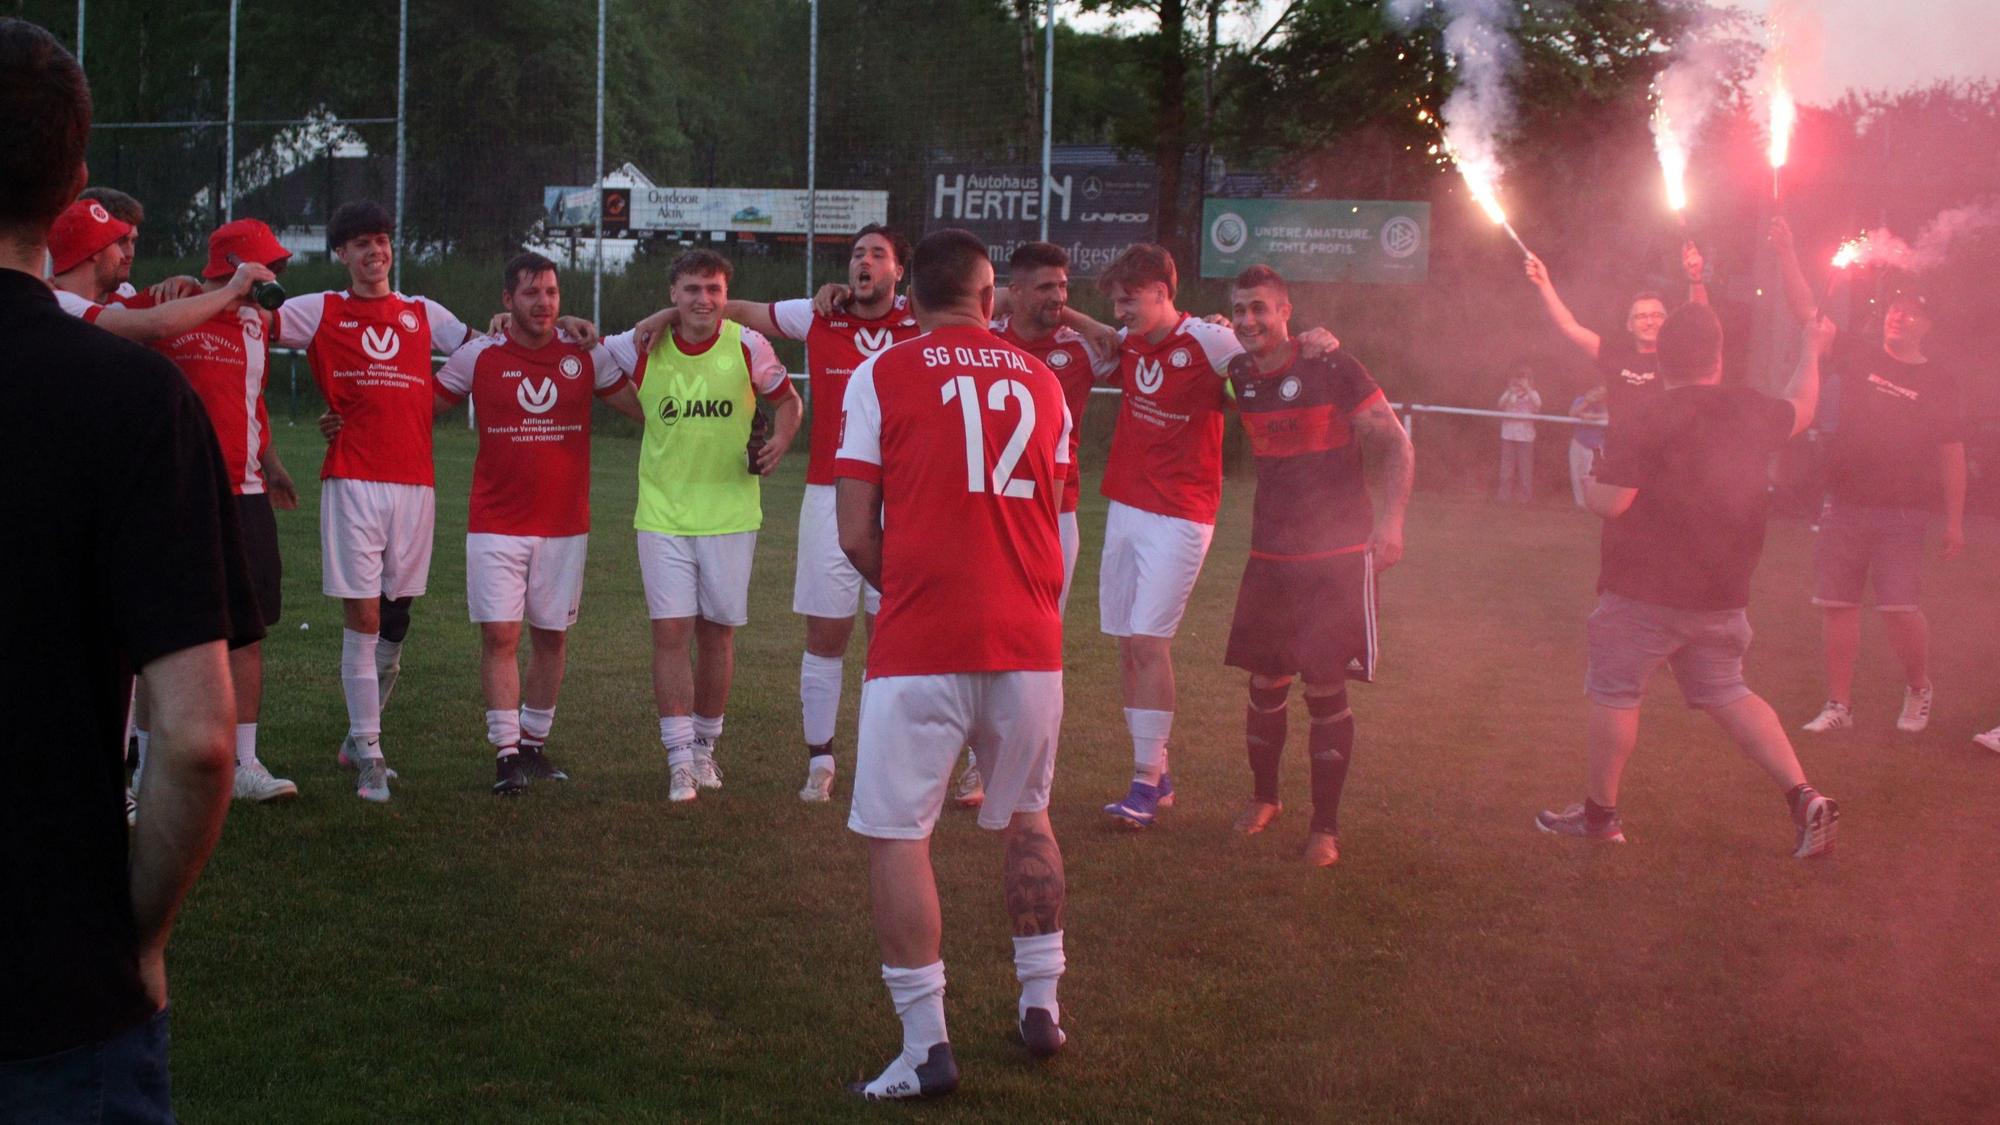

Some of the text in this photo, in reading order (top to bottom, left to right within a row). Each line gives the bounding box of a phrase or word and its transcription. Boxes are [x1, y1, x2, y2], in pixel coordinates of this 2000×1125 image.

[967, 174, 1038, 189] Autohaus
[648, 189, 699, 205] Outdoor
[934, 174, 1073, 221] HERTEN
[657, 206, 685, 218] Aktiv
[1081, 212, 1149, 222] UNIMOG
[1255, 226, 1373, 240] UNSERE AMATEURE.
[1269, 241, 1356, 254] ECHTE PROFIS.
[339, 320, 359, 328] JAKO
[923, 346, 1033, 374] SG OLEFTAL
[369, 363, 398, 372] Allfinanz
[502, 370, 522, 378] JAKO
[333, 370, 425, 386] Deutsche Vermögensberatung
[683, 400, 733, 418] JAKO
[487, 424, 582, 433] Deutsche Vermögensberatung
[940, 375, 1036, 499] 12
